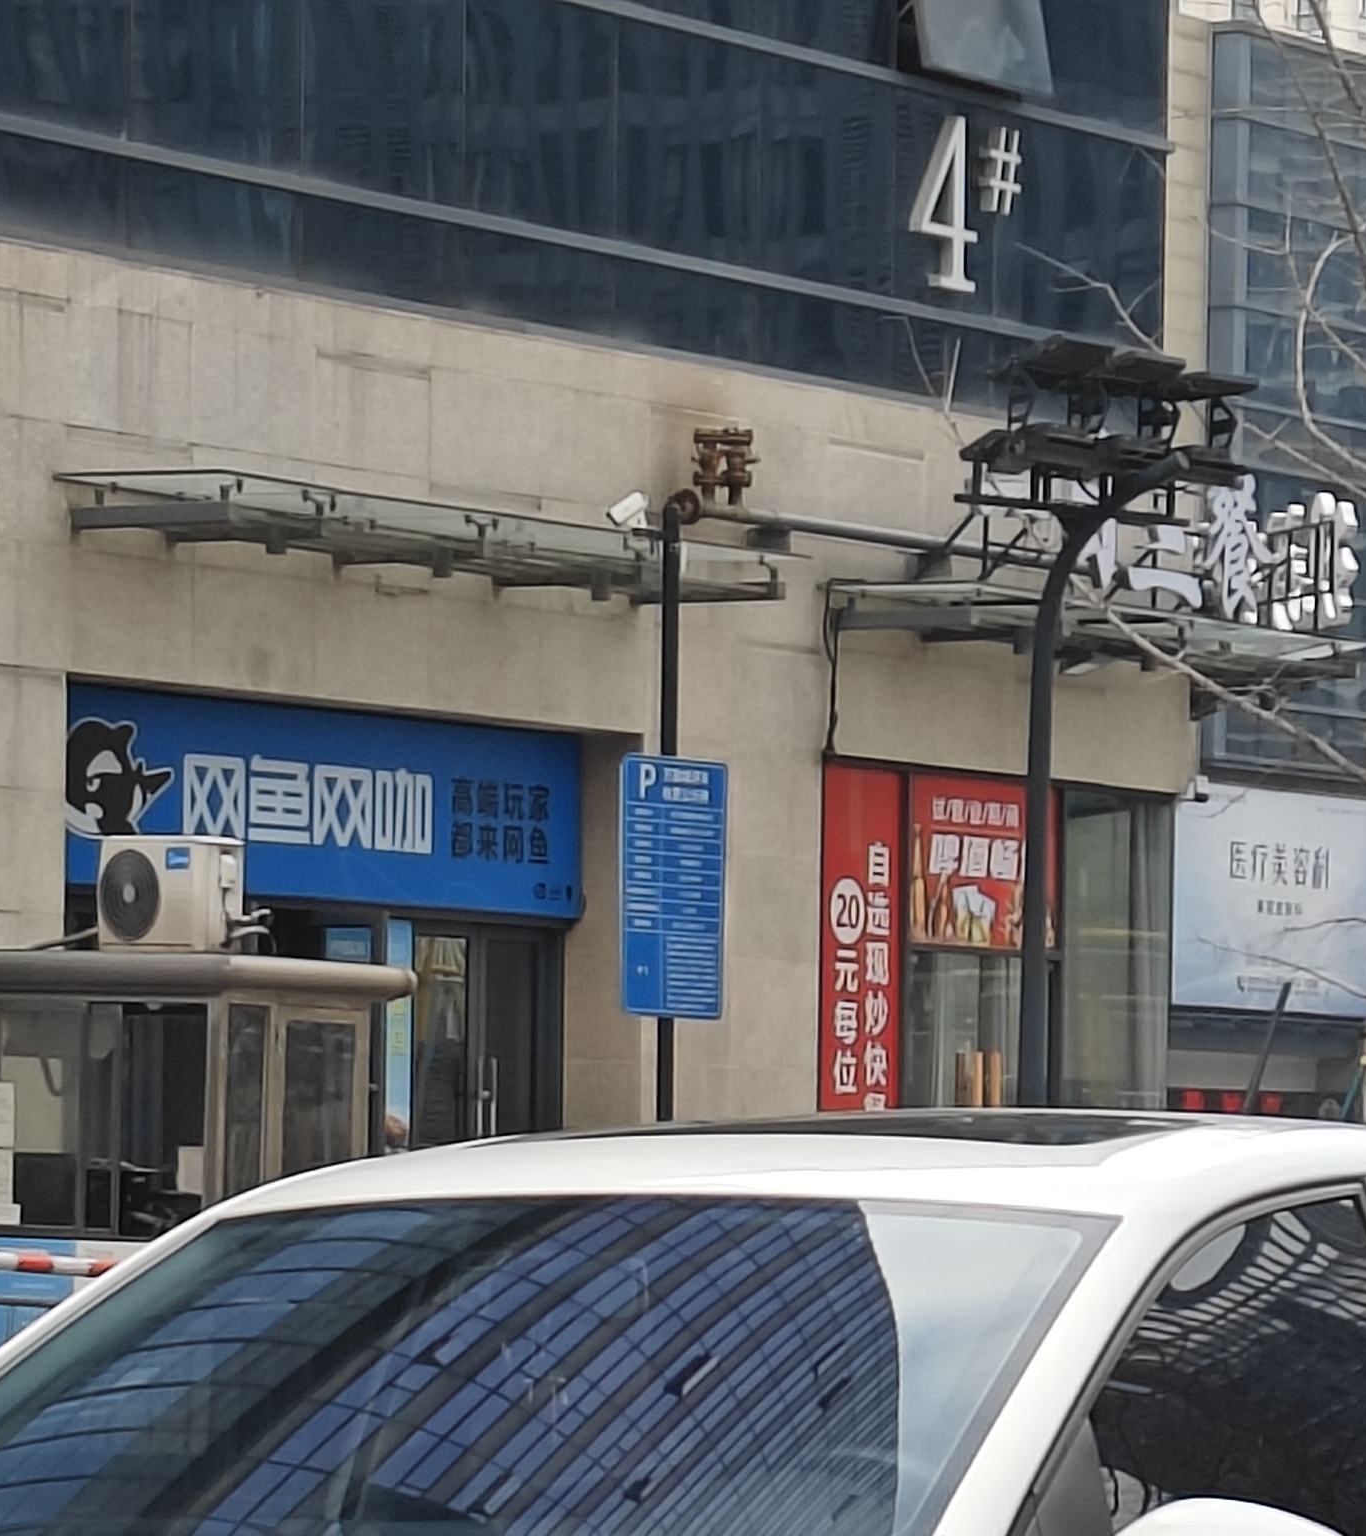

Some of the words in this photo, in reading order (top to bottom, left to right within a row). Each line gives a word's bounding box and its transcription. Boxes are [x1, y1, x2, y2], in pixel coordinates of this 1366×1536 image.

[183, 753, 433, 855] 网鱼网咖
[639, 763, 657, 800] P
